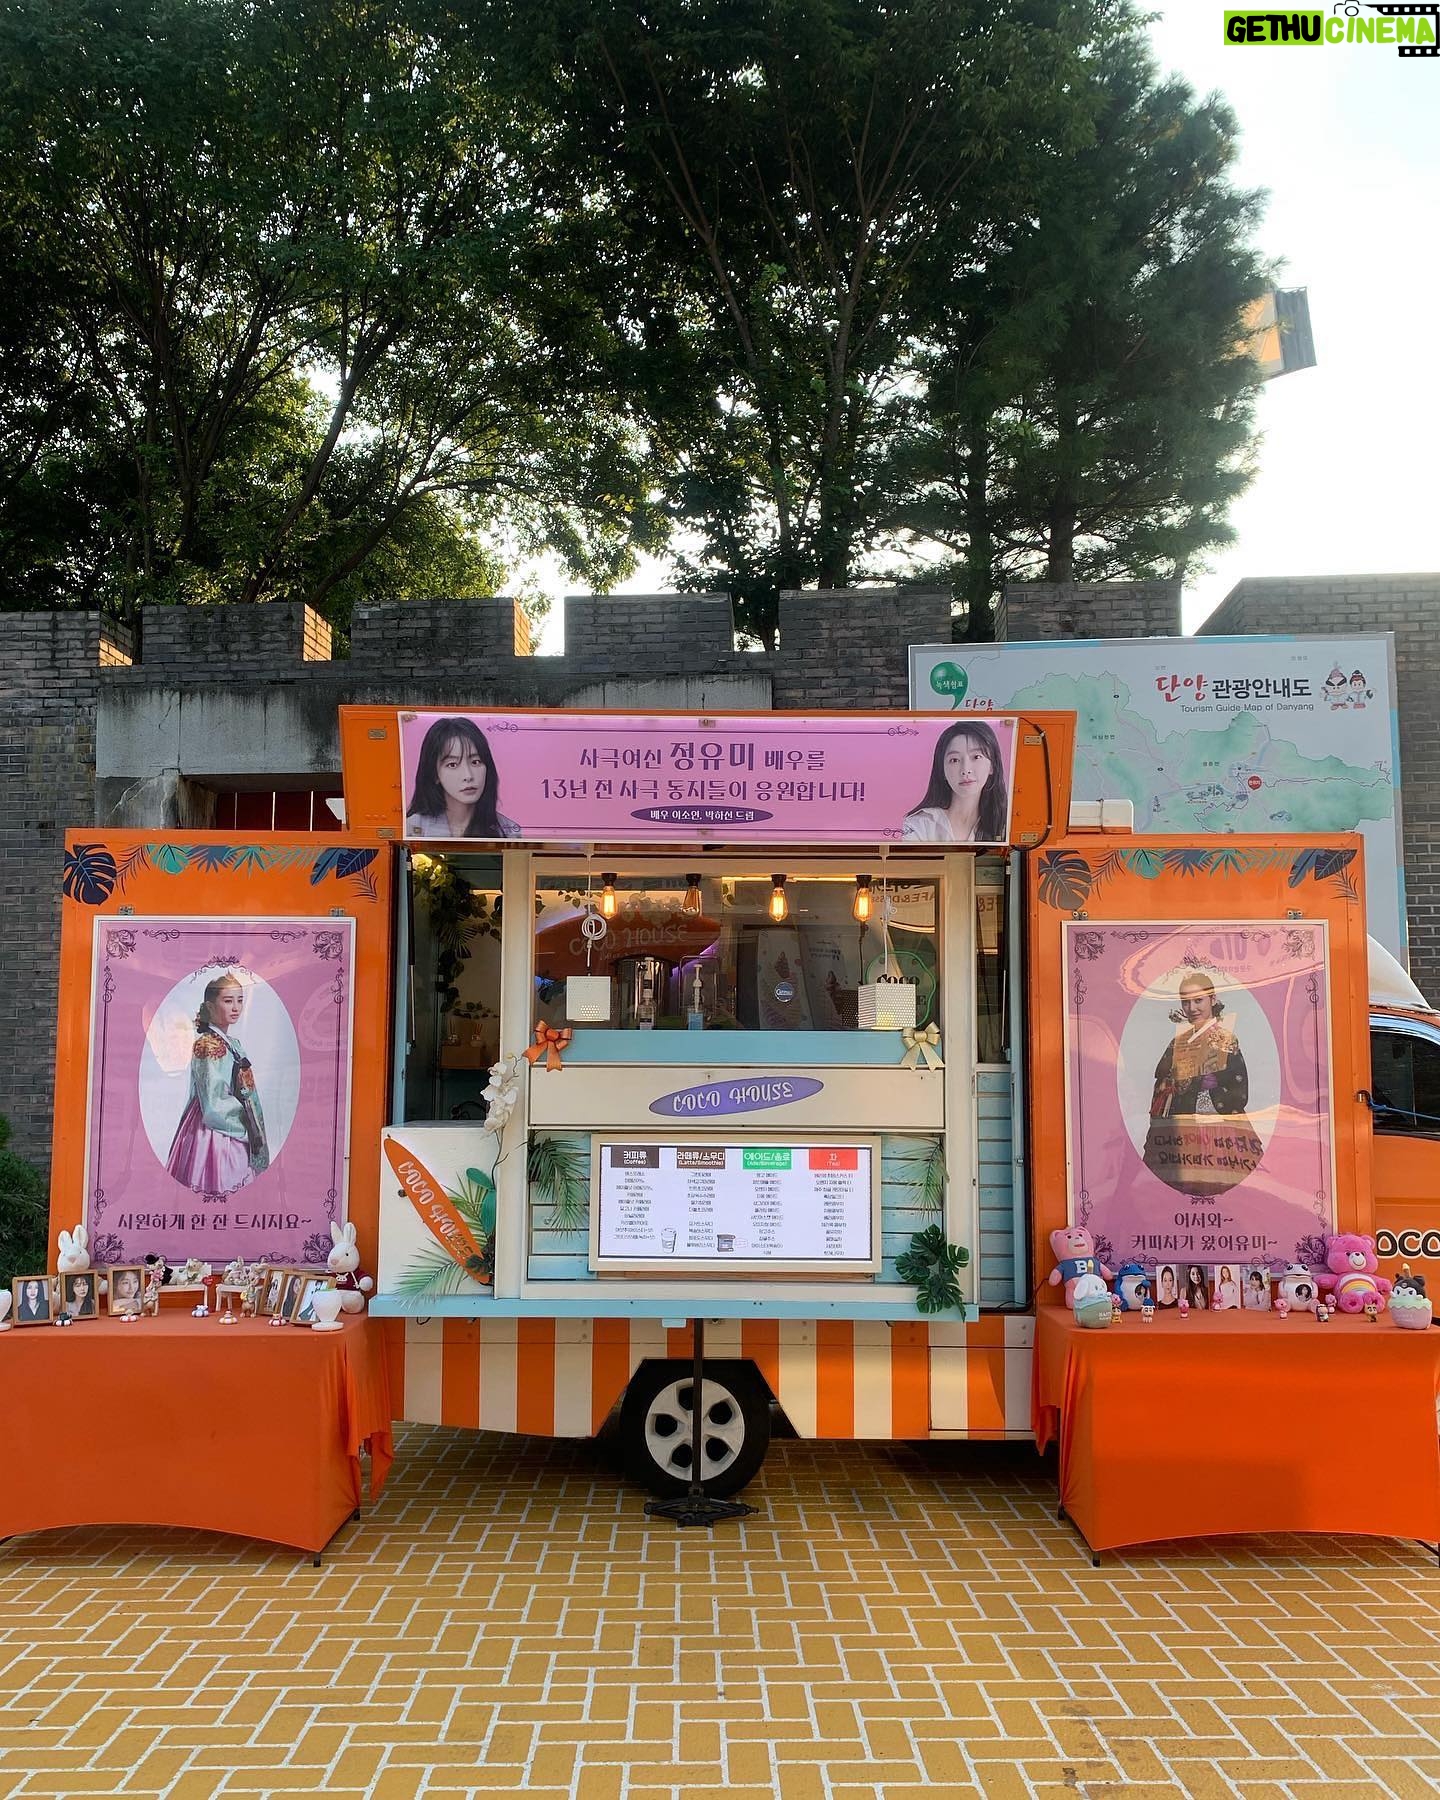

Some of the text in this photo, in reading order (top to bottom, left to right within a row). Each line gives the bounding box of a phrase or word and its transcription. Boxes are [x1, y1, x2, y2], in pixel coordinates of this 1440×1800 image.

[1155, 674, 1313, 702] 단양 관광안내도
[1180, 702, 1314, 714] Tourism Guide Map of Danyang
[580, 741, 826, 771] 사극여신 정유미 배우를
[541, 778, 865, 802] 13년 전 사극 동지들이 응원합니다!
[650, 810, 669, 820] 배우
[705, 810, 733, 821] 박하선
[735, 811, 754, 821] 드림
[673, 1082, 793, 1112] COCO HOUSE
[623, 1151, 647, 1160] 커피류
[397, 1160, 436, 1205] COCO
[118, 1213, 312, 1231] 시원하게 한 잔 드시지요~
[1174, 1212, 1234, 1228] 어서와~
[1131, 1234, 1278, 1251] 커피차가 왔어유미~
